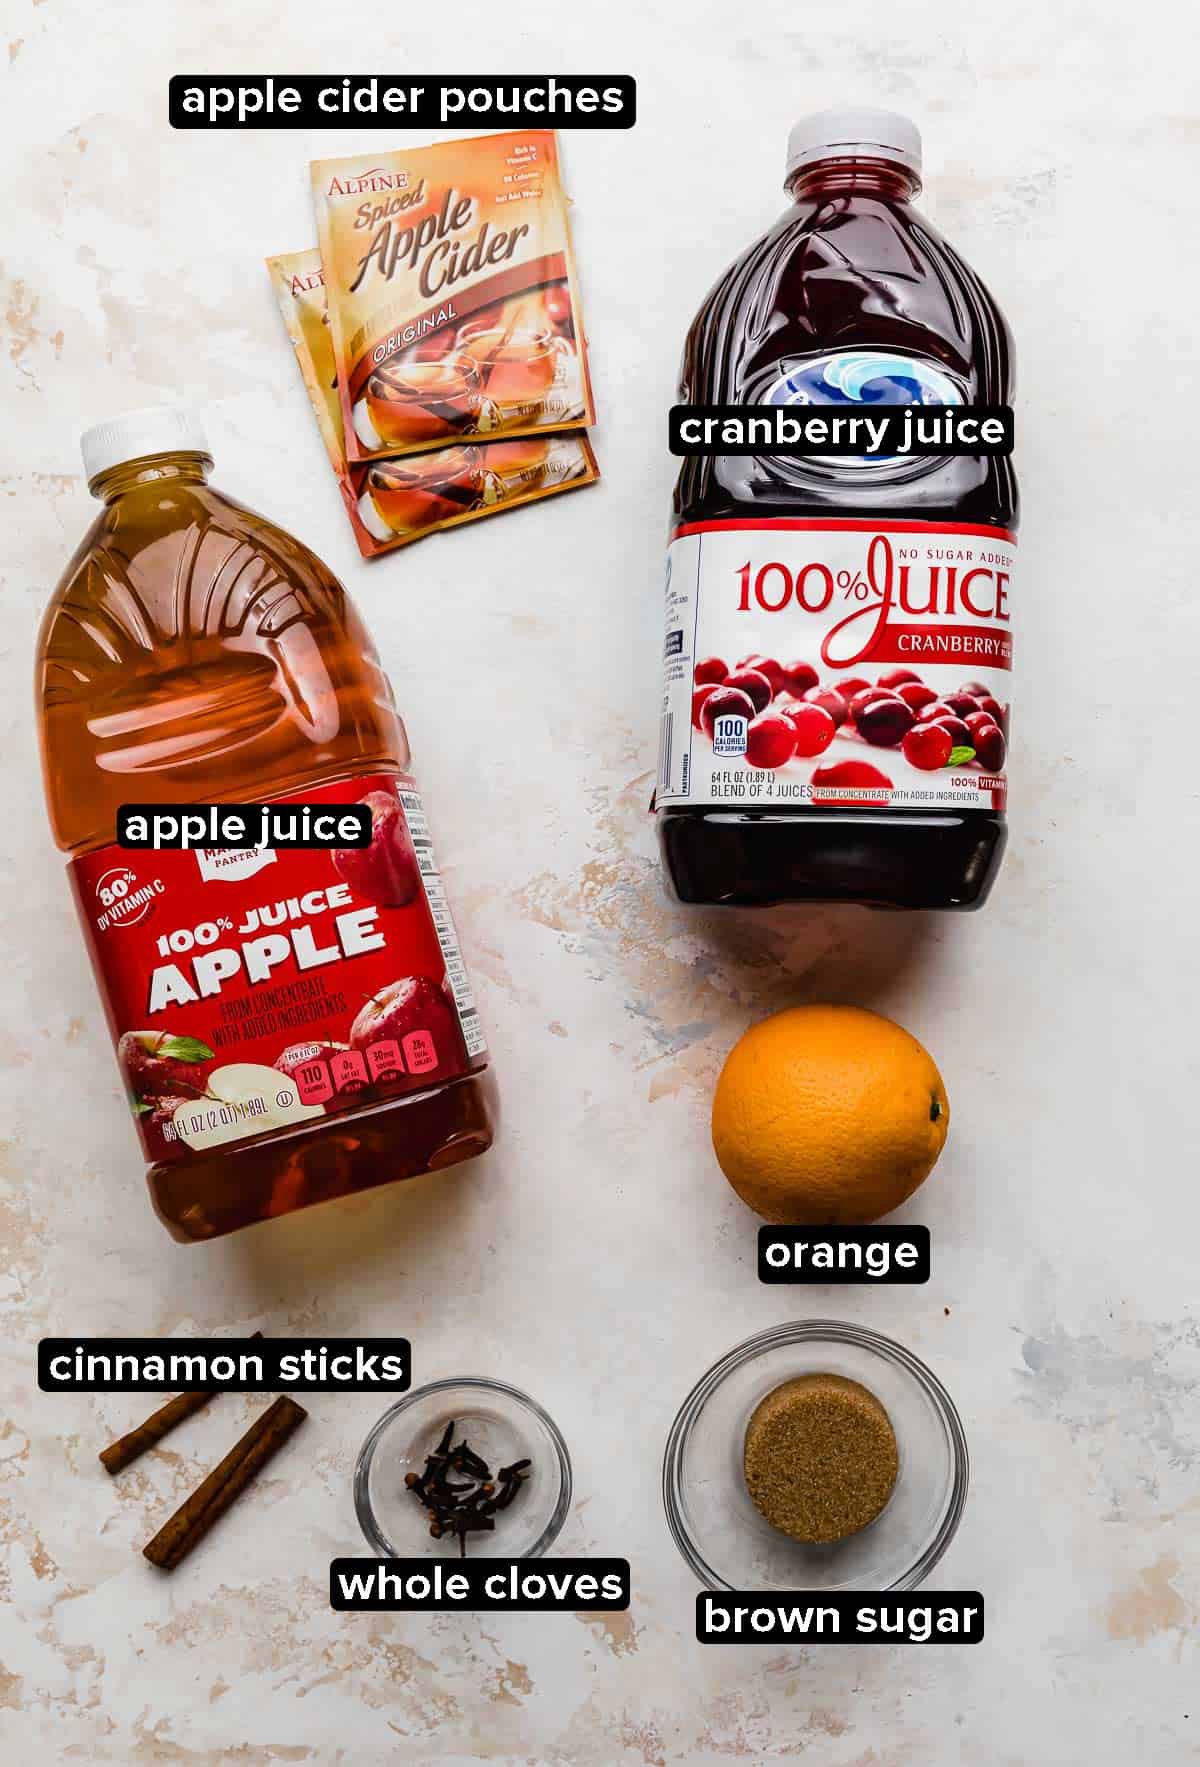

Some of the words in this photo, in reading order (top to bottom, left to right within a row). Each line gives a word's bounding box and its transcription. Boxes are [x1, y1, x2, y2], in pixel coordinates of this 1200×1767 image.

[327, 170, 409, 196] ALPINE
[354, 178, 426, 231] Spiced
[349, 187, 473, 293] Apple
[419, 221, 530, 299] Cider
[373, 303, 457, 363] ORIGINAL
[899, 548, 918, 560] NO
[927, 548, 973, 561] SUGAR
[735, 560, 870, 614] 100%
[820, 534, 1010, 670] JUICE
[897, 634, 1001, 656] CRANBERRY
[716, 719, 744, 737] 100
[711, 771, 721, 783] 64
[723, 771, 732, 783] FL
[734, 772, 744, 783] OZ
[711, 784, 746, 797] BLEND
[749, 784, 764, 797] OF
[766, 785, 774, 797] 4
[776, 784, 813, 799] JUICES
[815, 789, 837, 800] FROM
[891, 790, 909, 801] WITH
[951, 777, 977, 788] 100%
[214, 848, 259, 868] PANTRY
[99, 871, 137, 907] 80%
[107, 884, 157, 921] VITAMIN
[153, 879, 166, 893] C
[156, 915, 234, 958] 100%
[238, 882, 354, 934] JUICE
[148, 905, 388, 1015] APPLE
[301, 1065, 322, 1084] 110
[162, 1121, 177, 1142] 64
[177, 1119, 190, 1137] FL
[190, 1114, 206, 1133] OZ
[206, 1110, 218, 1130] (2
[219, 1103, 238, 1125] QT)
[239, 1097, 269, 1119] 1.89L
